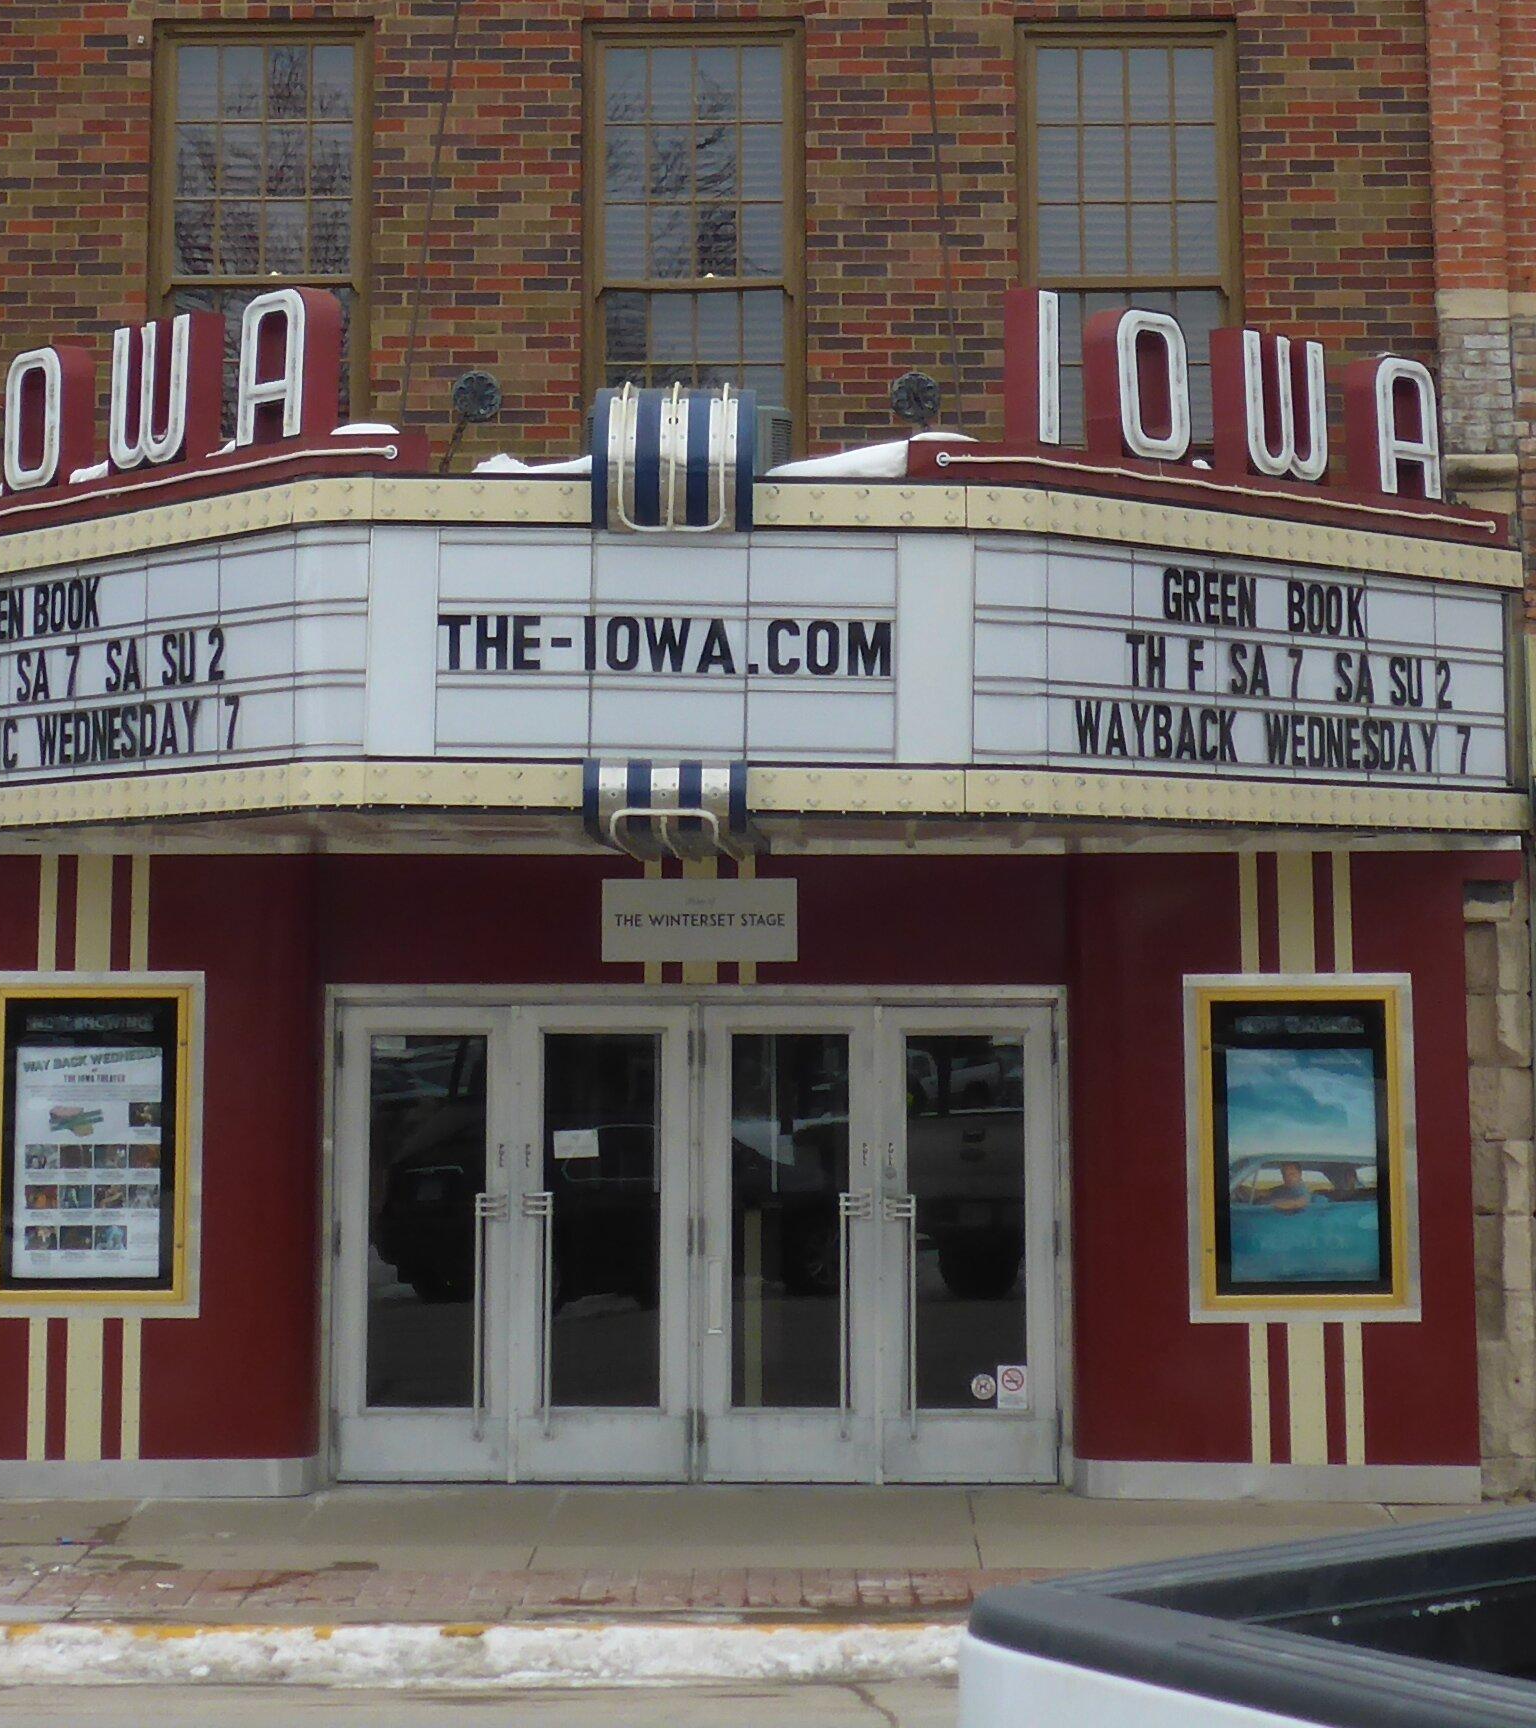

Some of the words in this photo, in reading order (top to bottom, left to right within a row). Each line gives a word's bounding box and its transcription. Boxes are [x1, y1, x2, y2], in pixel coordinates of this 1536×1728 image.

[1037, 289, 1443, 499] IOWA
[33, 576, 101, 635] BOOK
[1163, 567, 1257, 629] GREEN
[1287, 580, 1365, 638] BOOK
[17, 649, 50, 703] SA
[65, 645, 81, 699] 7
[105, 638, 142, 693] SA
[161, 630, 197, 686] SU
[208, 627, 225, 682] 2
[438, 614, 892, 677] THE-IOWA.COM
[1228, 643, 1270, 698] SA
[1288, 647, 1303, 700] 7
[1336, 652, 1375, 704] SA
[1388, 656, 1424, 708] SU
[1436, 660, 1453, 710] 2
[36, 699, 200, 767] WEDNESDAY
[224, 695, 240, 750] 7
[1074, 699, 1238, 763] WAYBACK
[1264, 713, 1437, 774] WEDNESDAY
[1457, 725, 1472, 775] 7
[615, 914, 643, 927] THE
[649, 914, 735, 927] WINTERSET
[740, 914, 786, 927] STAGE
[24, 1059, 51, 1072] WAY
[53, 1055, 87, 1070] BACK
